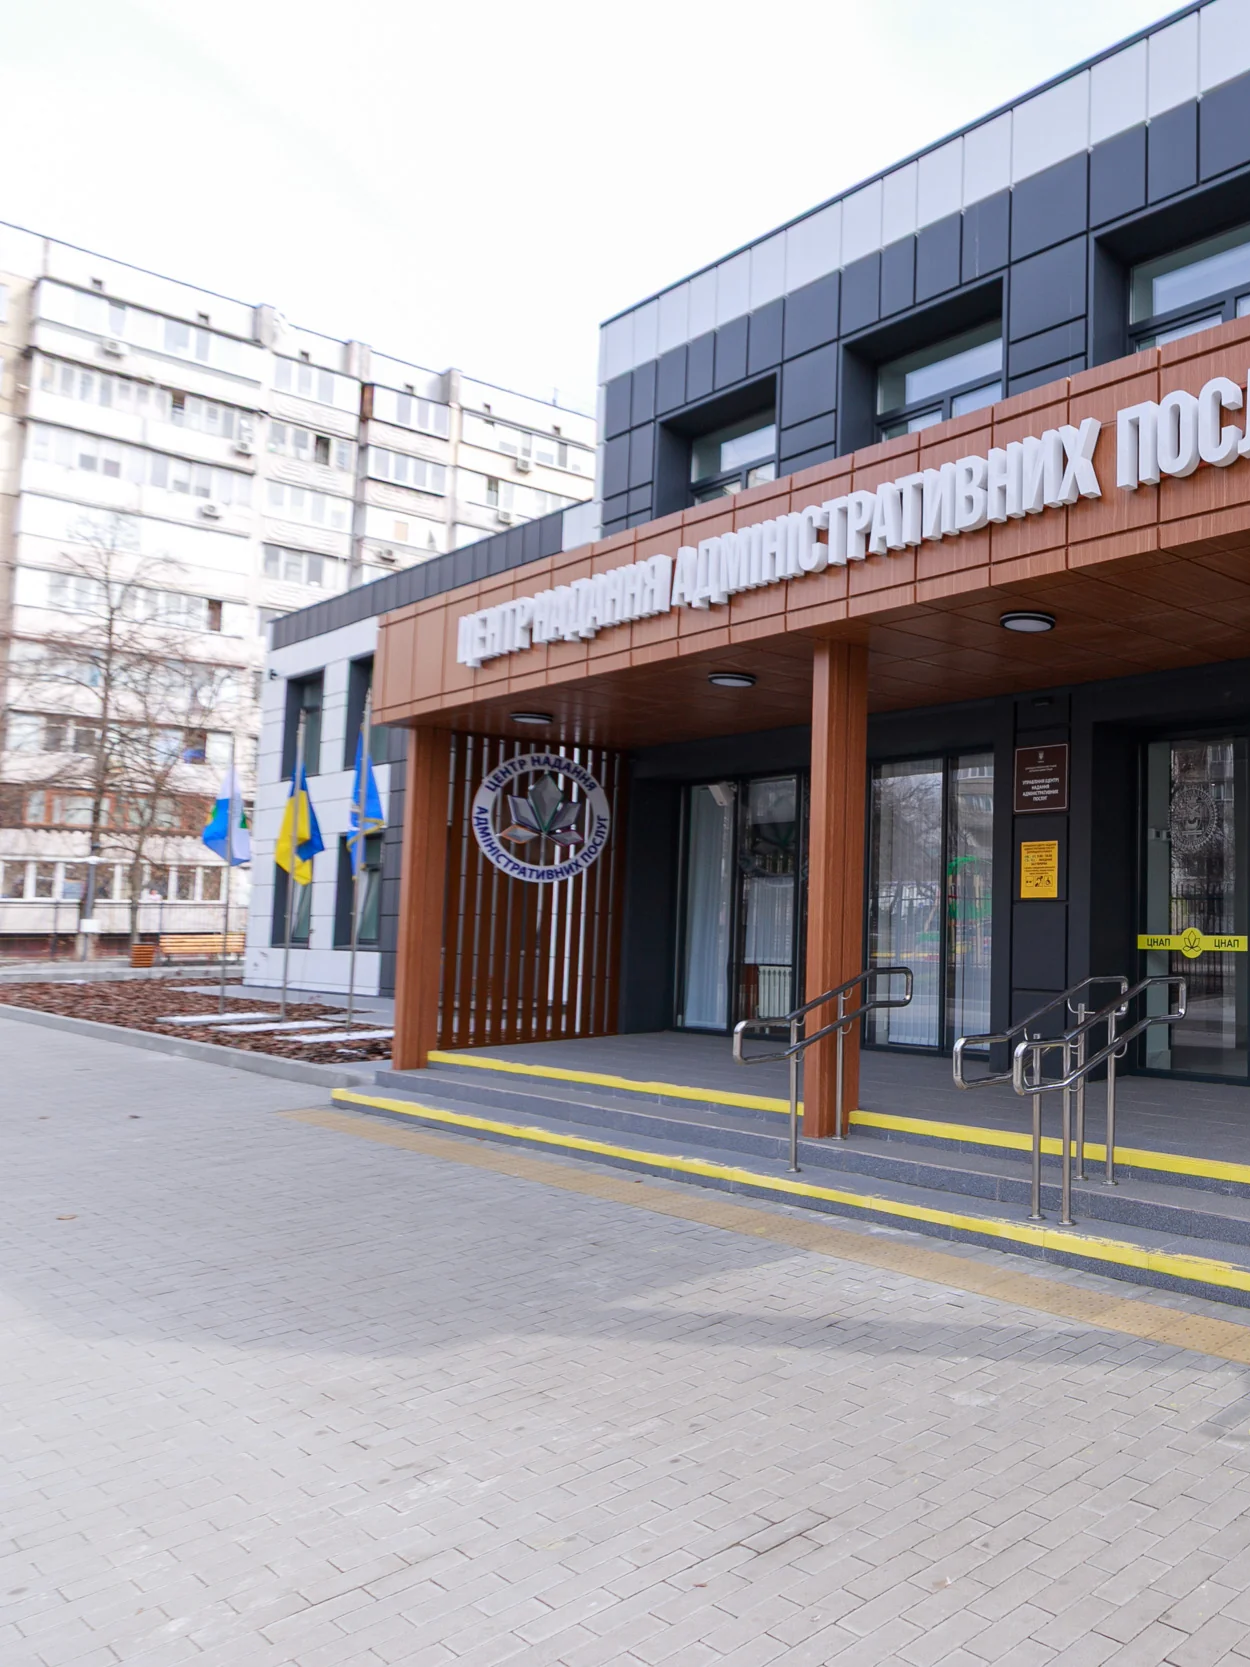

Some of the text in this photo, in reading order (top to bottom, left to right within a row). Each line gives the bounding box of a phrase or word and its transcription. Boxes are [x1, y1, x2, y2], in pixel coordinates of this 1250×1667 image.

[457, 597, 534, 668] ЦЕНТР
[532, 554, 672, 643] НАДАННЯ
[671, 417, 1101, 609] АДМІНІСТРАТИВНИХ
[485, 756, 597, 793] ЦЕНТР НАДАННЯ
[473, 806, 608, 880] АДМІНІСТРАТИВНИХ ПОСЛУГ
[1146, 938, 1240, 949] ЦНАП ЦНАП
